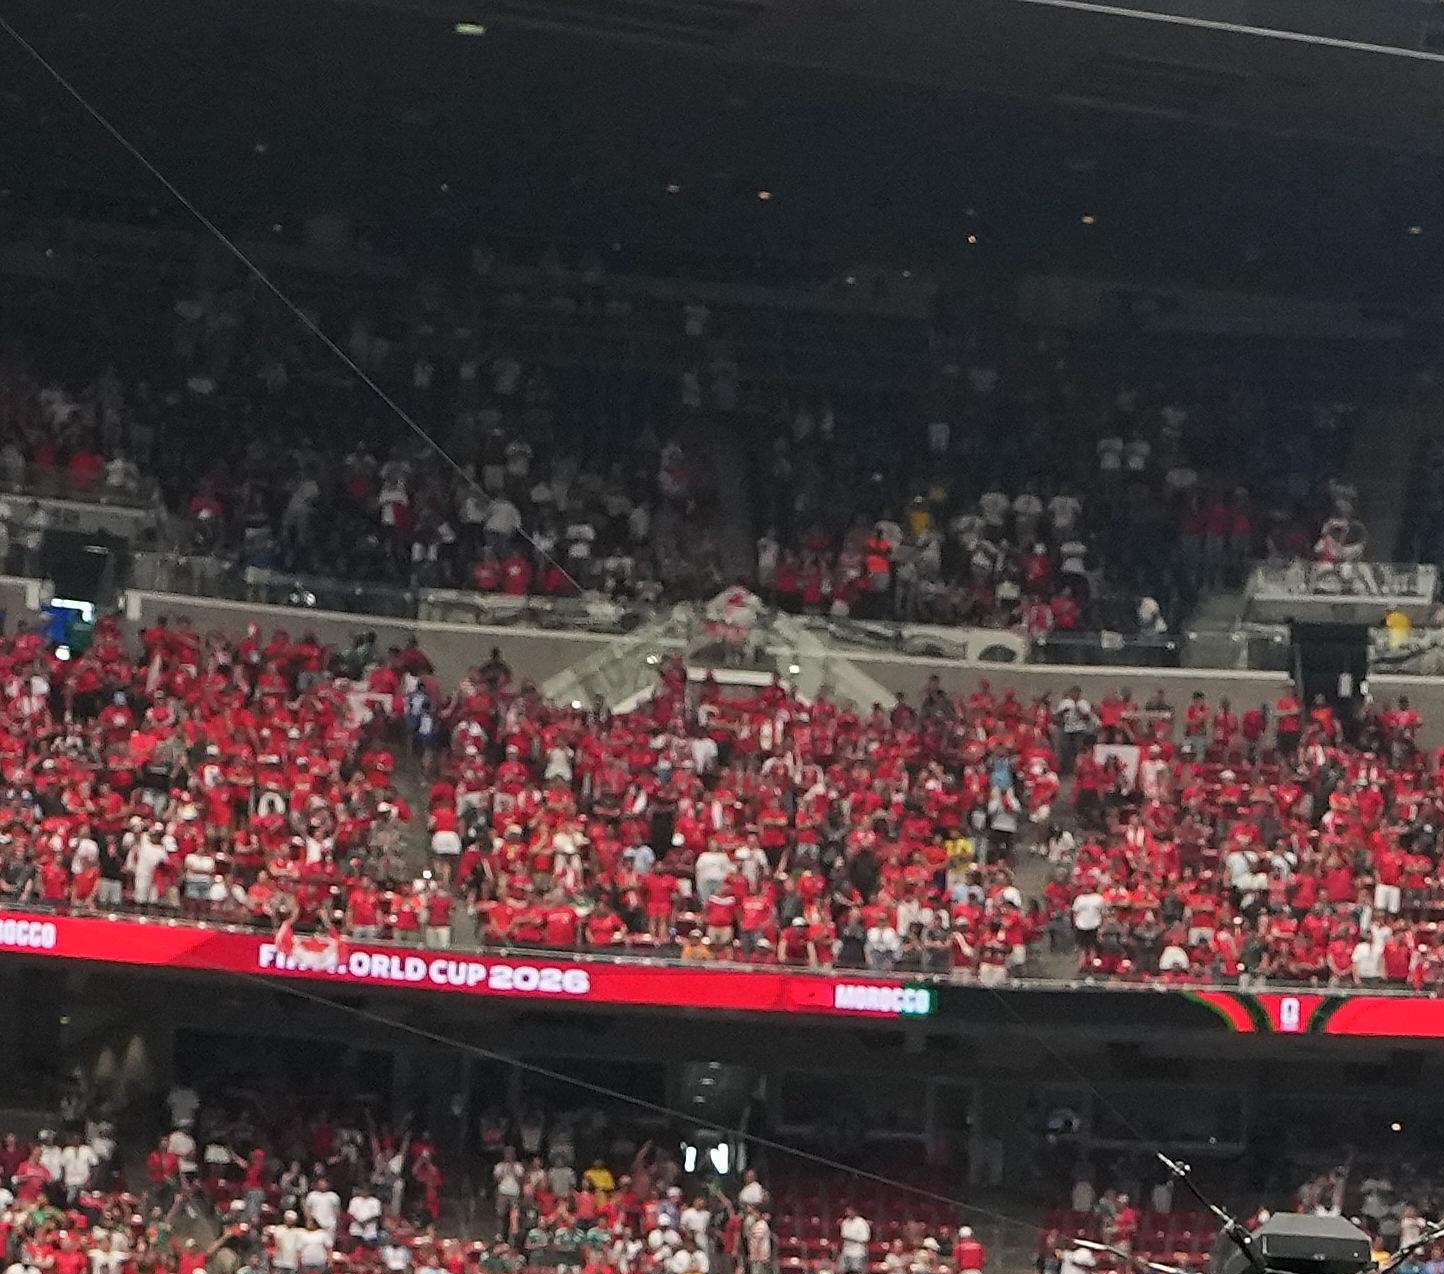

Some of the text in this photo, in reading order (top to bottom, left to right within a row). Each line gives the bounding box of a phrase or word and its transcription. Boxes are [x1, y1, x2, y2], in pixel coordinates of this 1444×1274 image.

[0, 918, 57, 949] OCCO
[328, 952, 427, 981] ORLD
[428, 959, 487, 986] CUP
[488, 964, 590, 993] 2026
